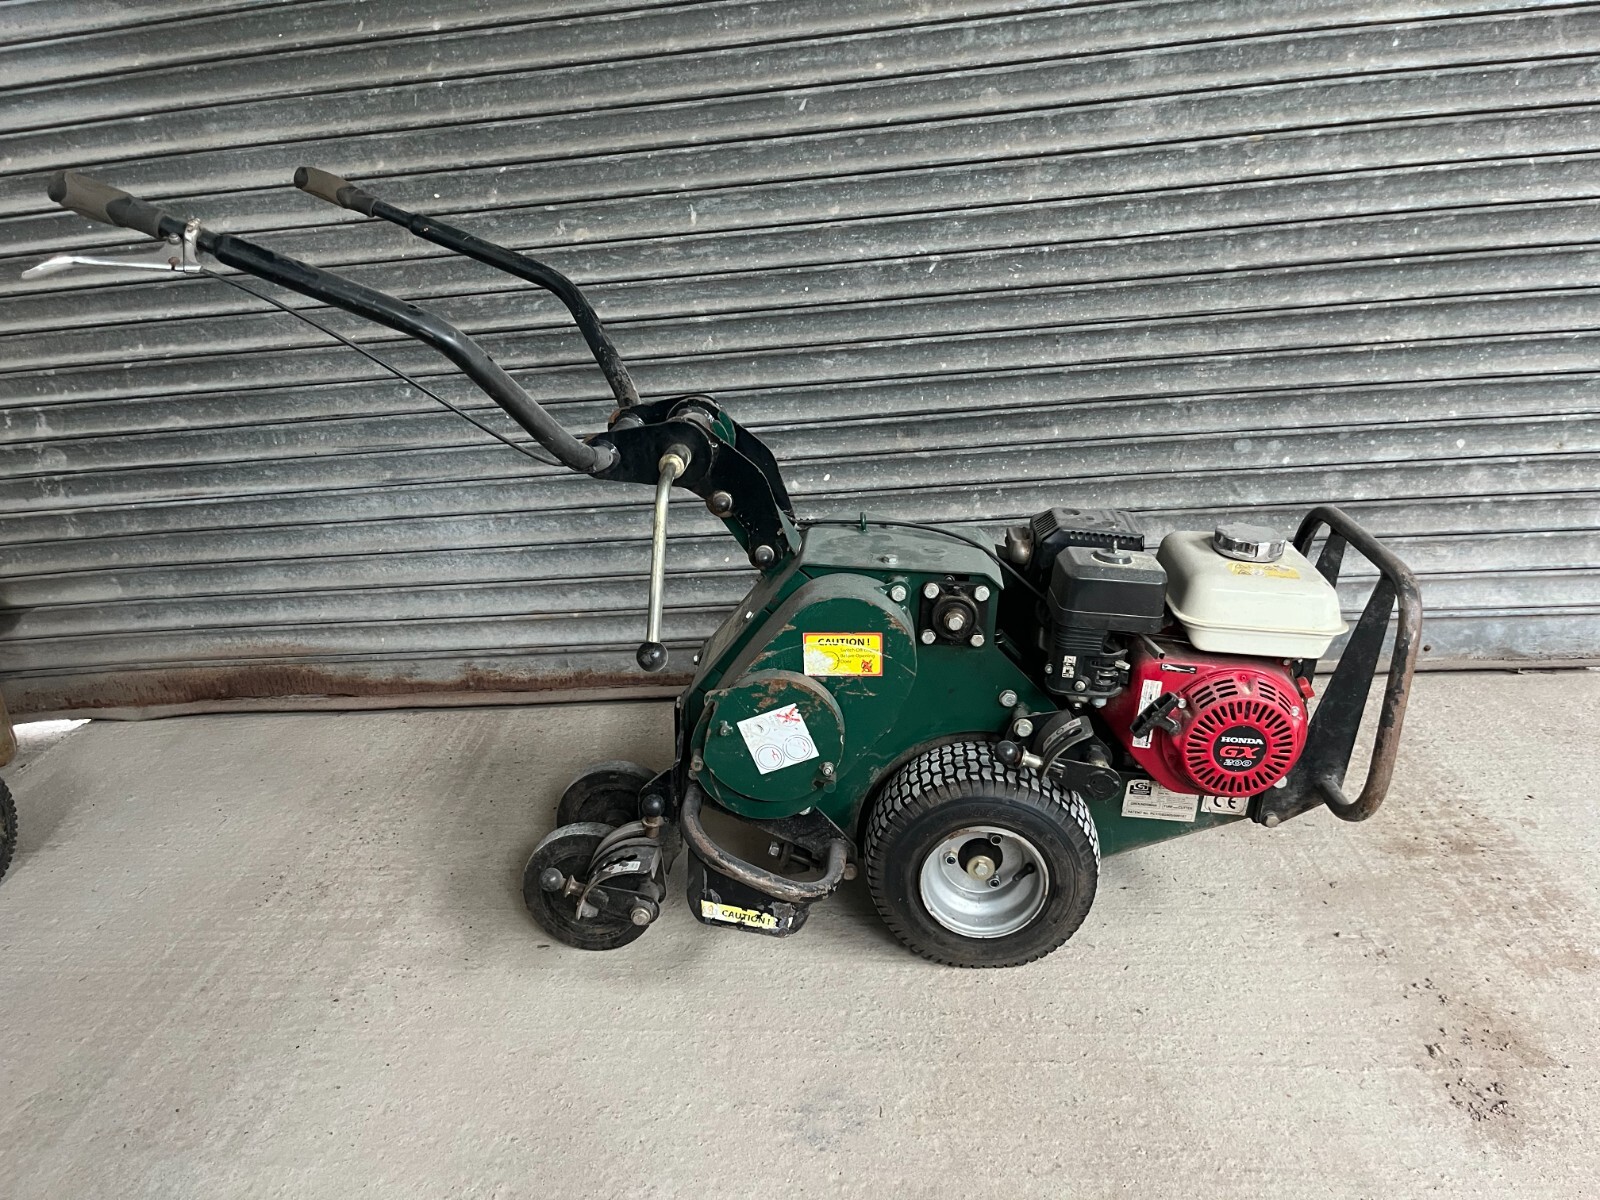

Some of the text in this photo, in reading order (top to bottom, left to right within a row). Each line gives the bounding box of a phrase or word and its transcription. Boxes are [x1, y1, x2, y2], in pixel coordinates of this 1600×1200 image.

[1220, 736, 1264, 745] HONDA
[1219, 745, 1261, 759] GX
[1223, 758, 1253, 767] 200
[1213, 795, 1237, 809] CE
